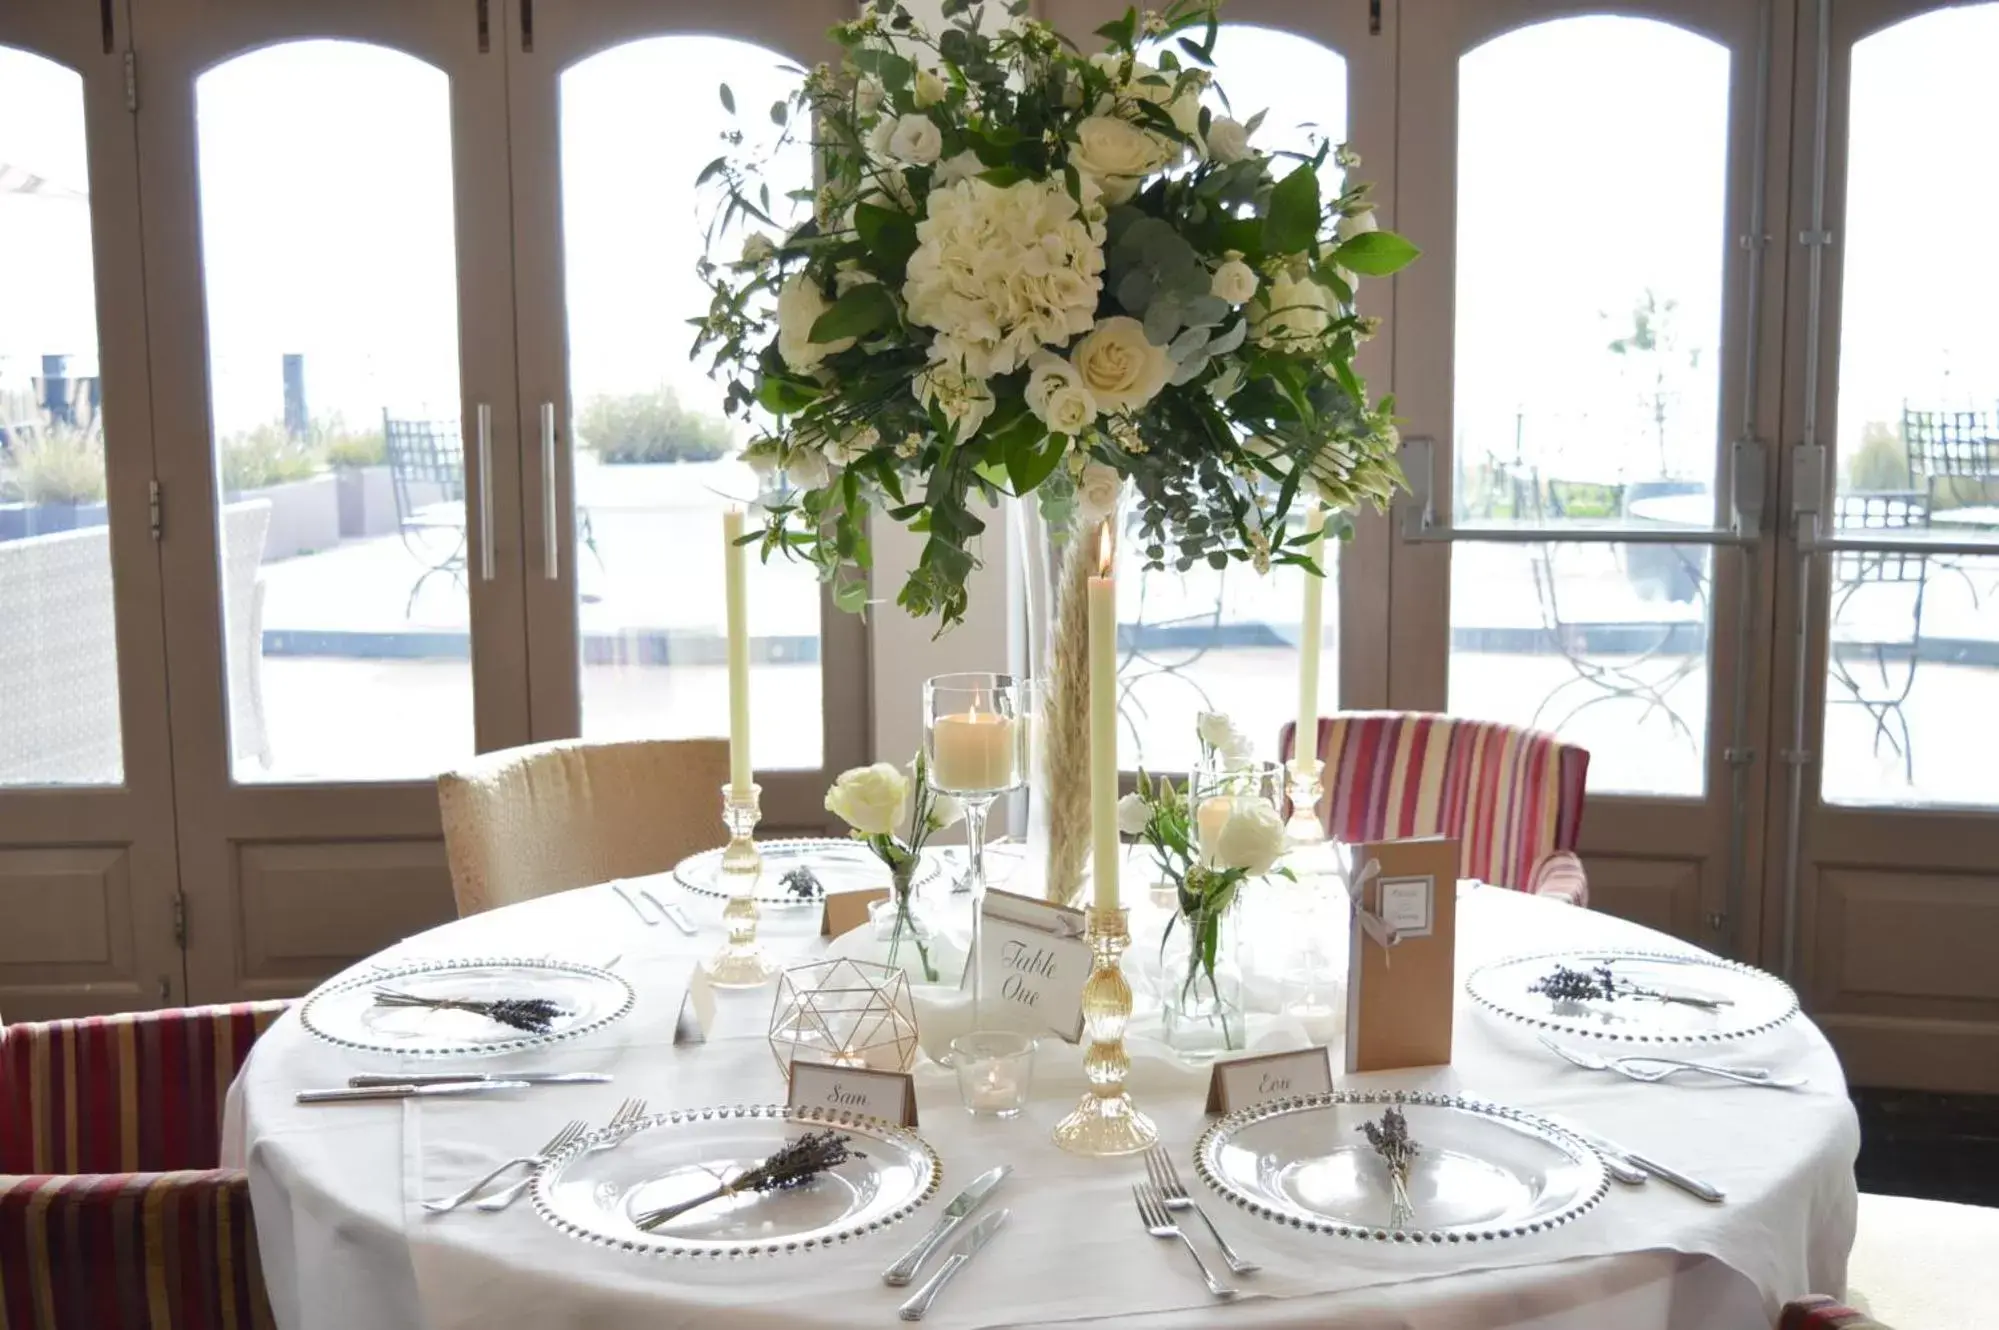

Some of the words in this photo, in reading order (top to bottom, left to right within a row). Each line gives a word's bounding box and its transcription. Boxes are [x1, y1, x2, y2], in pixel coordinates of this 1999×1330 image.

[1002, 940, 1056, 980] Table
[1001, 973, 1040, 1007] One
[826, 1082, 868, 1106] Sam
